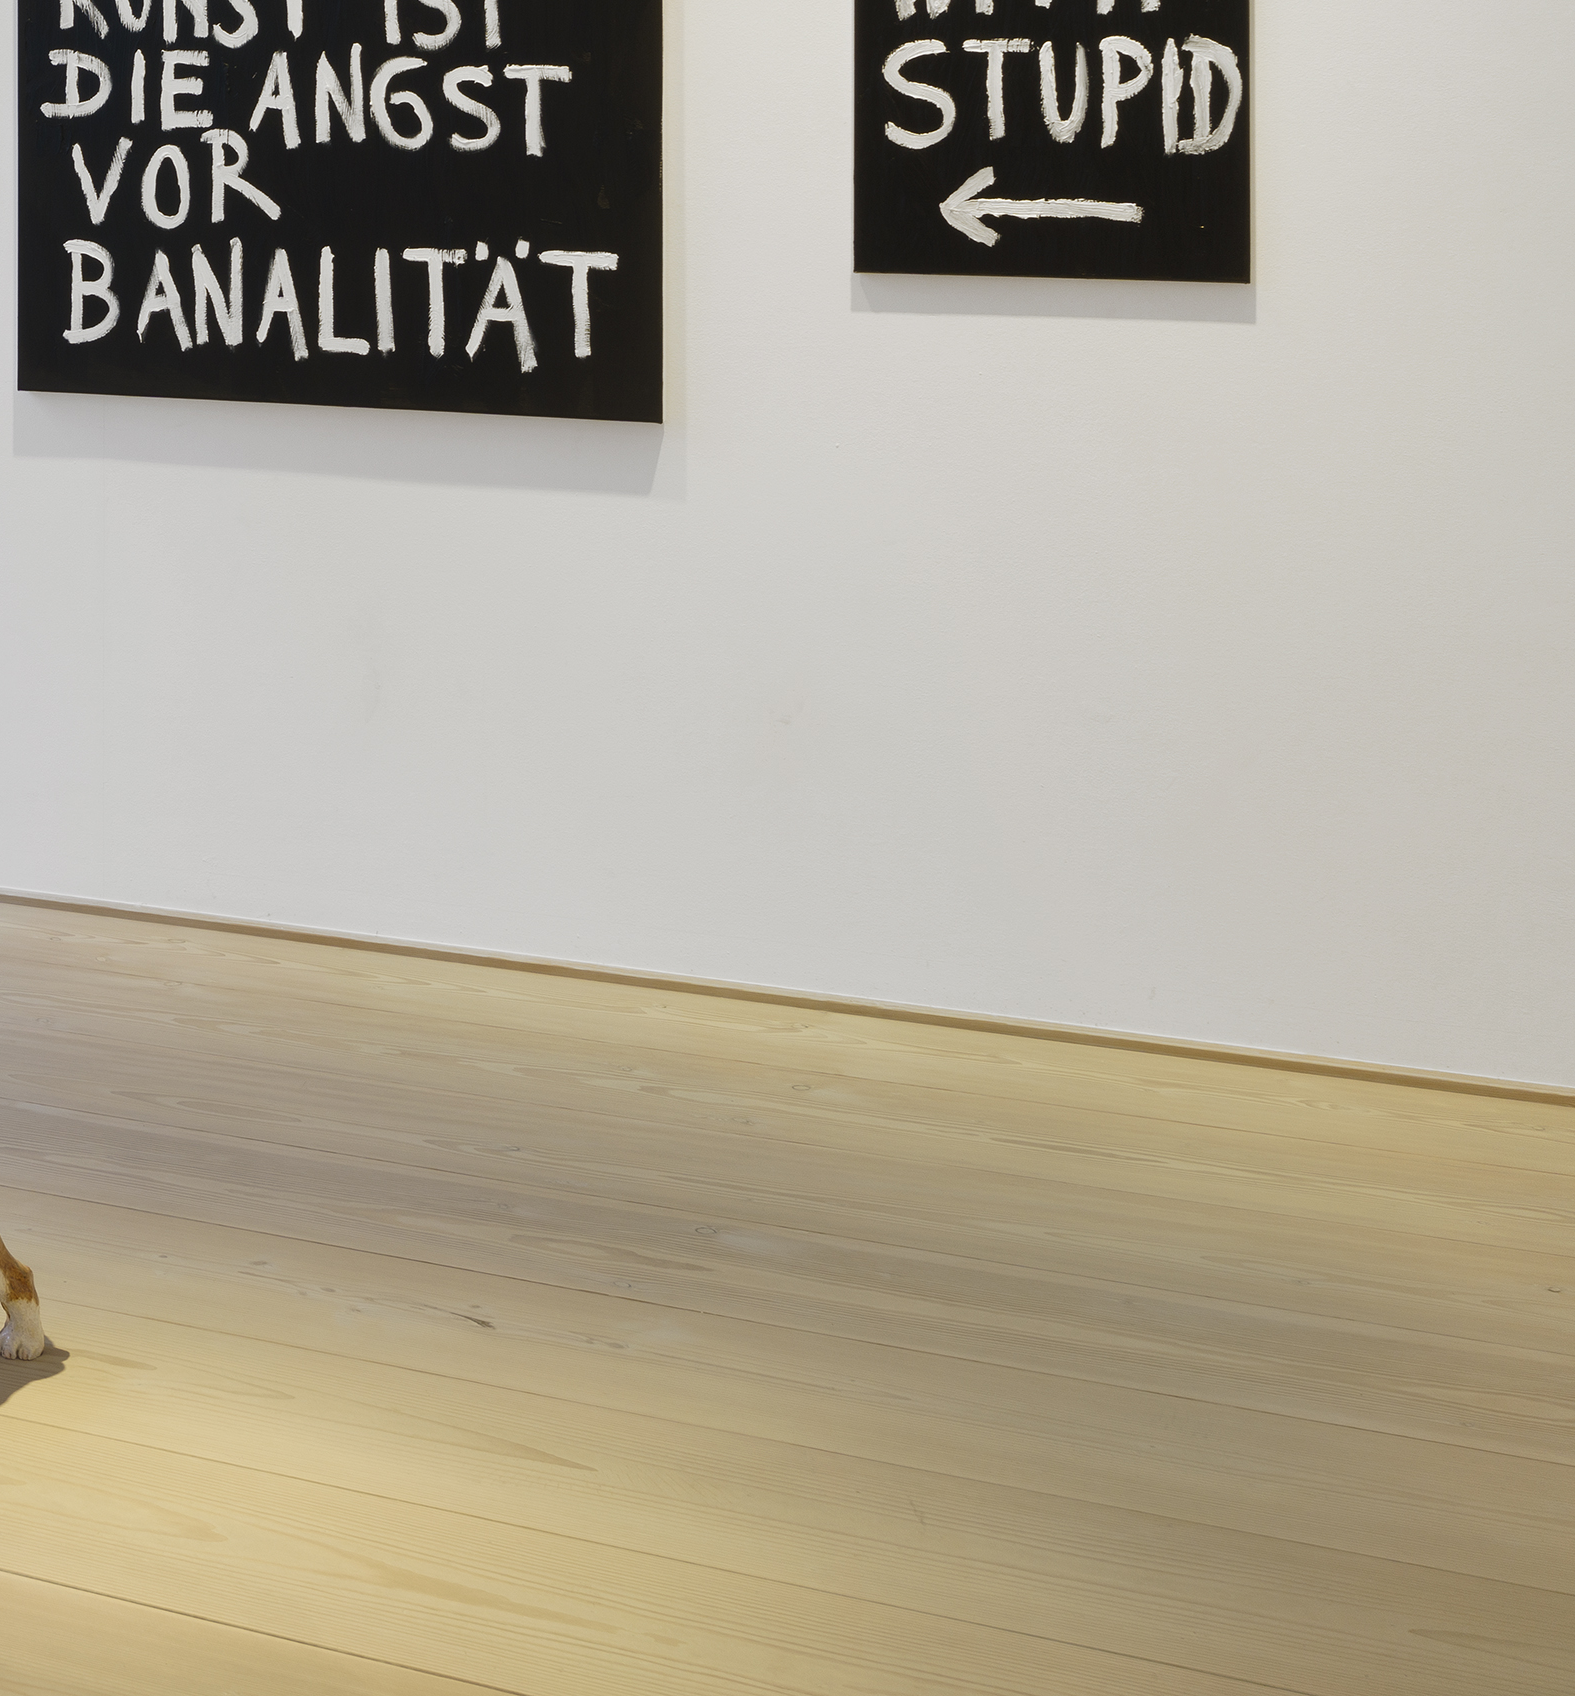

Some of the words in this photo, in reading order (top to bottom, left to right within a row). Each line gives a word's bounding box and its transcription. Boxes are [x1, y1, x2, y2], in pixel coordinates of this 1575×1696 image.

[40, 49, 213, 131] DIE
[249, 43, 572, 156] ANGST
[882, 34, 1242, 154] STUPID
[72, 129, 281, 229] VOR
[63, 237, 619, 373] BANALITÄT
